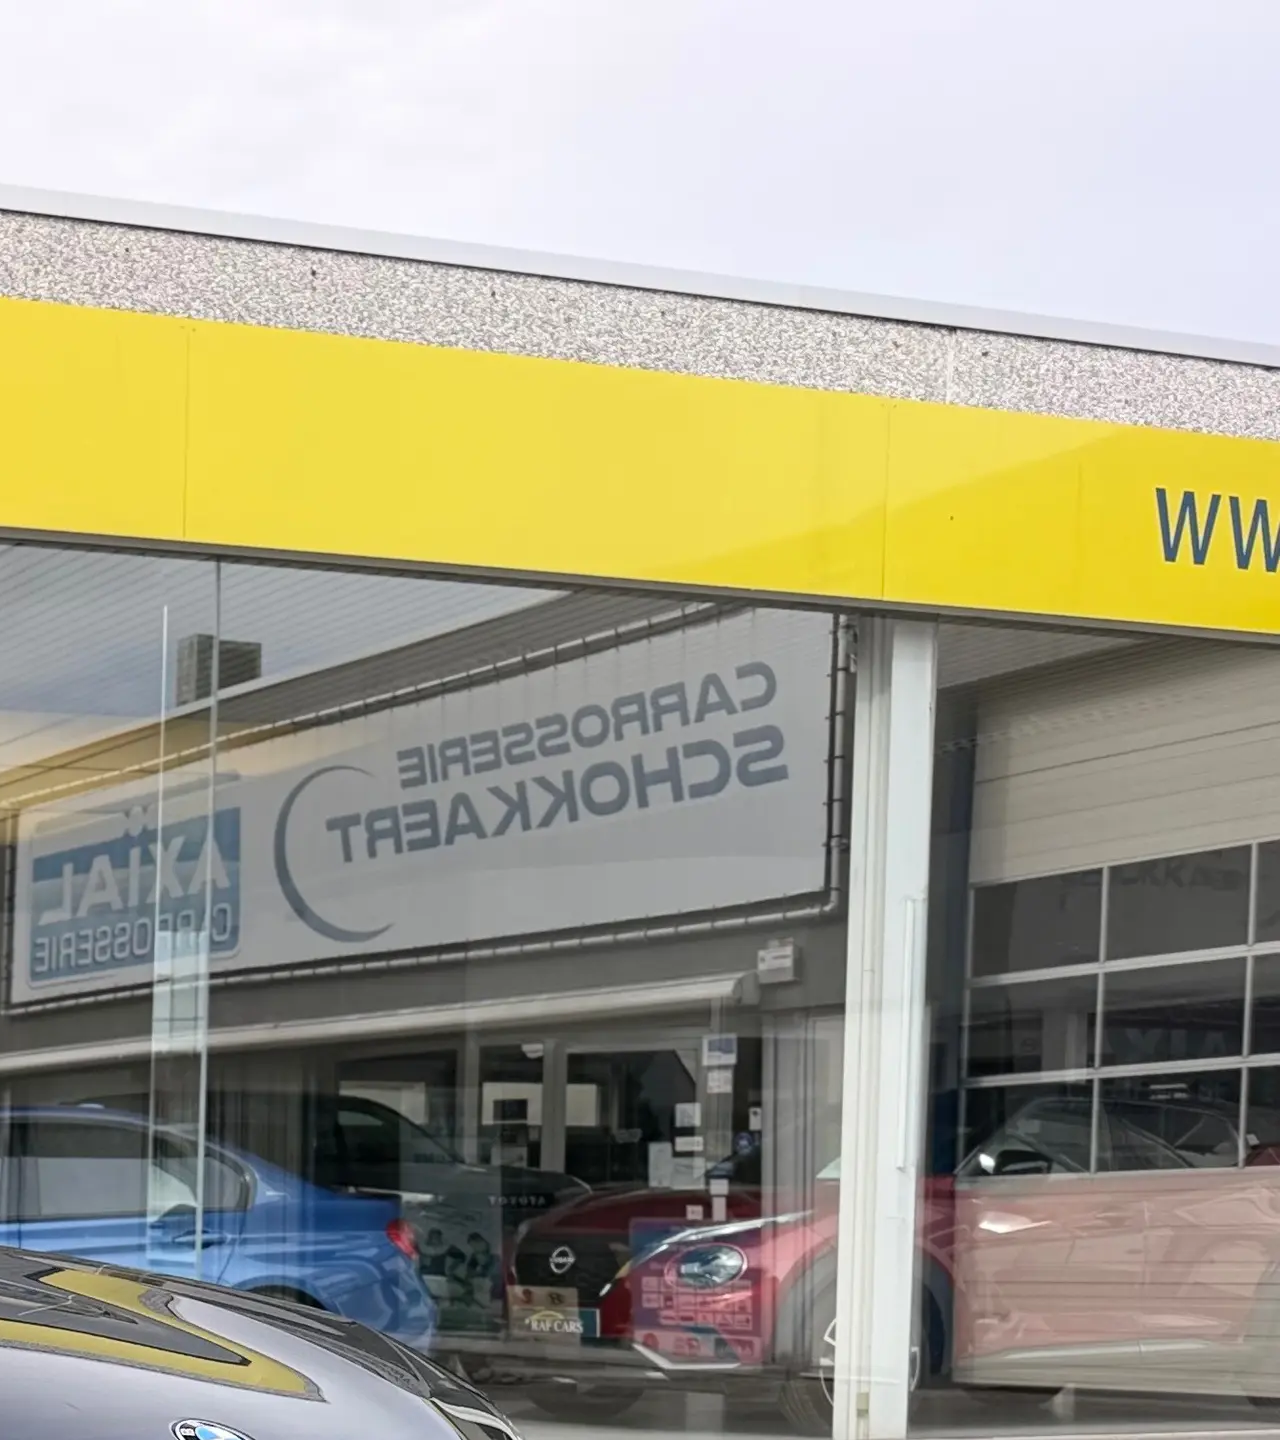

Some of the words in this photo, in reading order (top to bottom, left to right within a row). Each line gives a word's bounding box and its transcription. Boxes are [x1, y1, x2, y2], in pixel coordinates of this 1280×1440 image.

[488, 1195, 546, 1206] TOYOTA
[530, 1320, 552, 1331] RAF
[553, 1320, 584, 1334] CARS
